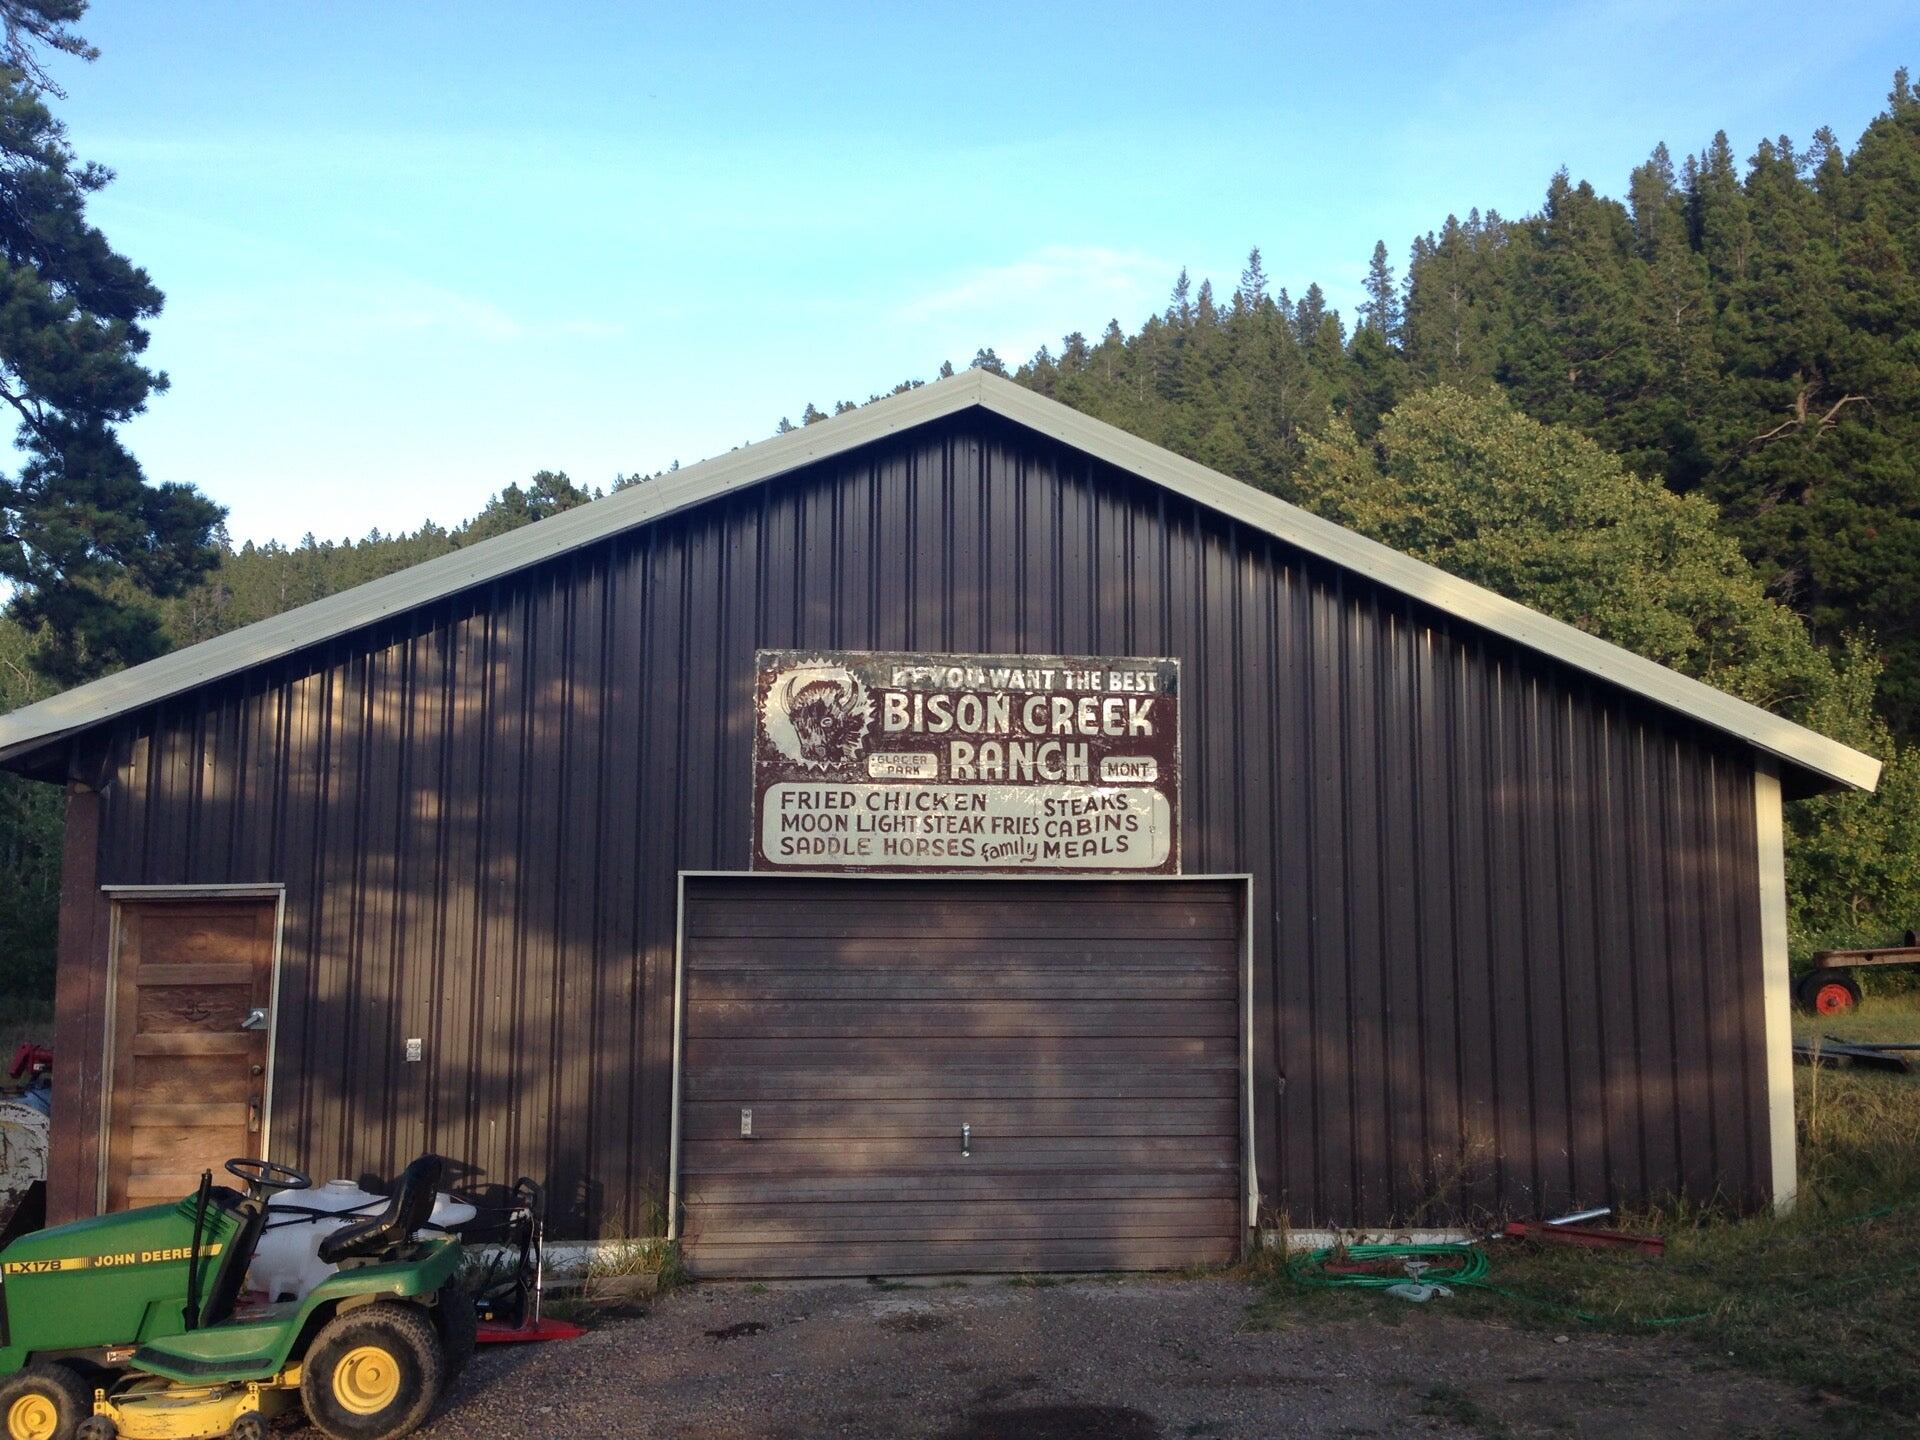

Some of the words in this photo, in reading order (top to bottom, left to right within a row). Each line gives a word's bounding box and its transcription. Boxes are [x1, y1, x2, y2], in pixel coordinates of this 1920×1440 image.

[928, 664, 985, 689] YOU
[989, 668, 1054, 690] WANT
[1063, 670, 1101, 690] THE
[1109, 671, 1157, 691] BEST
[884, 693, 1010, 734] BISON
[1023, 696, 1155, 736] CREEK
[887, 765, 919, 775] PARK
[950, 741, 1089, 781] RANCH
[1108, 762, 1150, 777] MONT
[781, 791, 856, 810] FRIED
[866, 792, 986, 811] CHICKEN
[1044, 794, 1128, 817] STEAKS
[781, 814, 848, 833] MOON
[857, 815, 917, 834] LIGHT
[923, 816, 985, 834] STEAK
[992, 817, 1039, 836] FRIES
[1045, 814, 1138, 838] CABINS
[780, 836, 873, 856] SADDLE
[884, 838, 976, 857] HORSES
[981, 836, 1037, 863] family
[1043, 835, 1129, 859] MEALS
[10, 1260, 62, 1273] LX178
[94, 1253, 136, 1267] JOHN
[142, 1247, 192, 1262] DEERE
